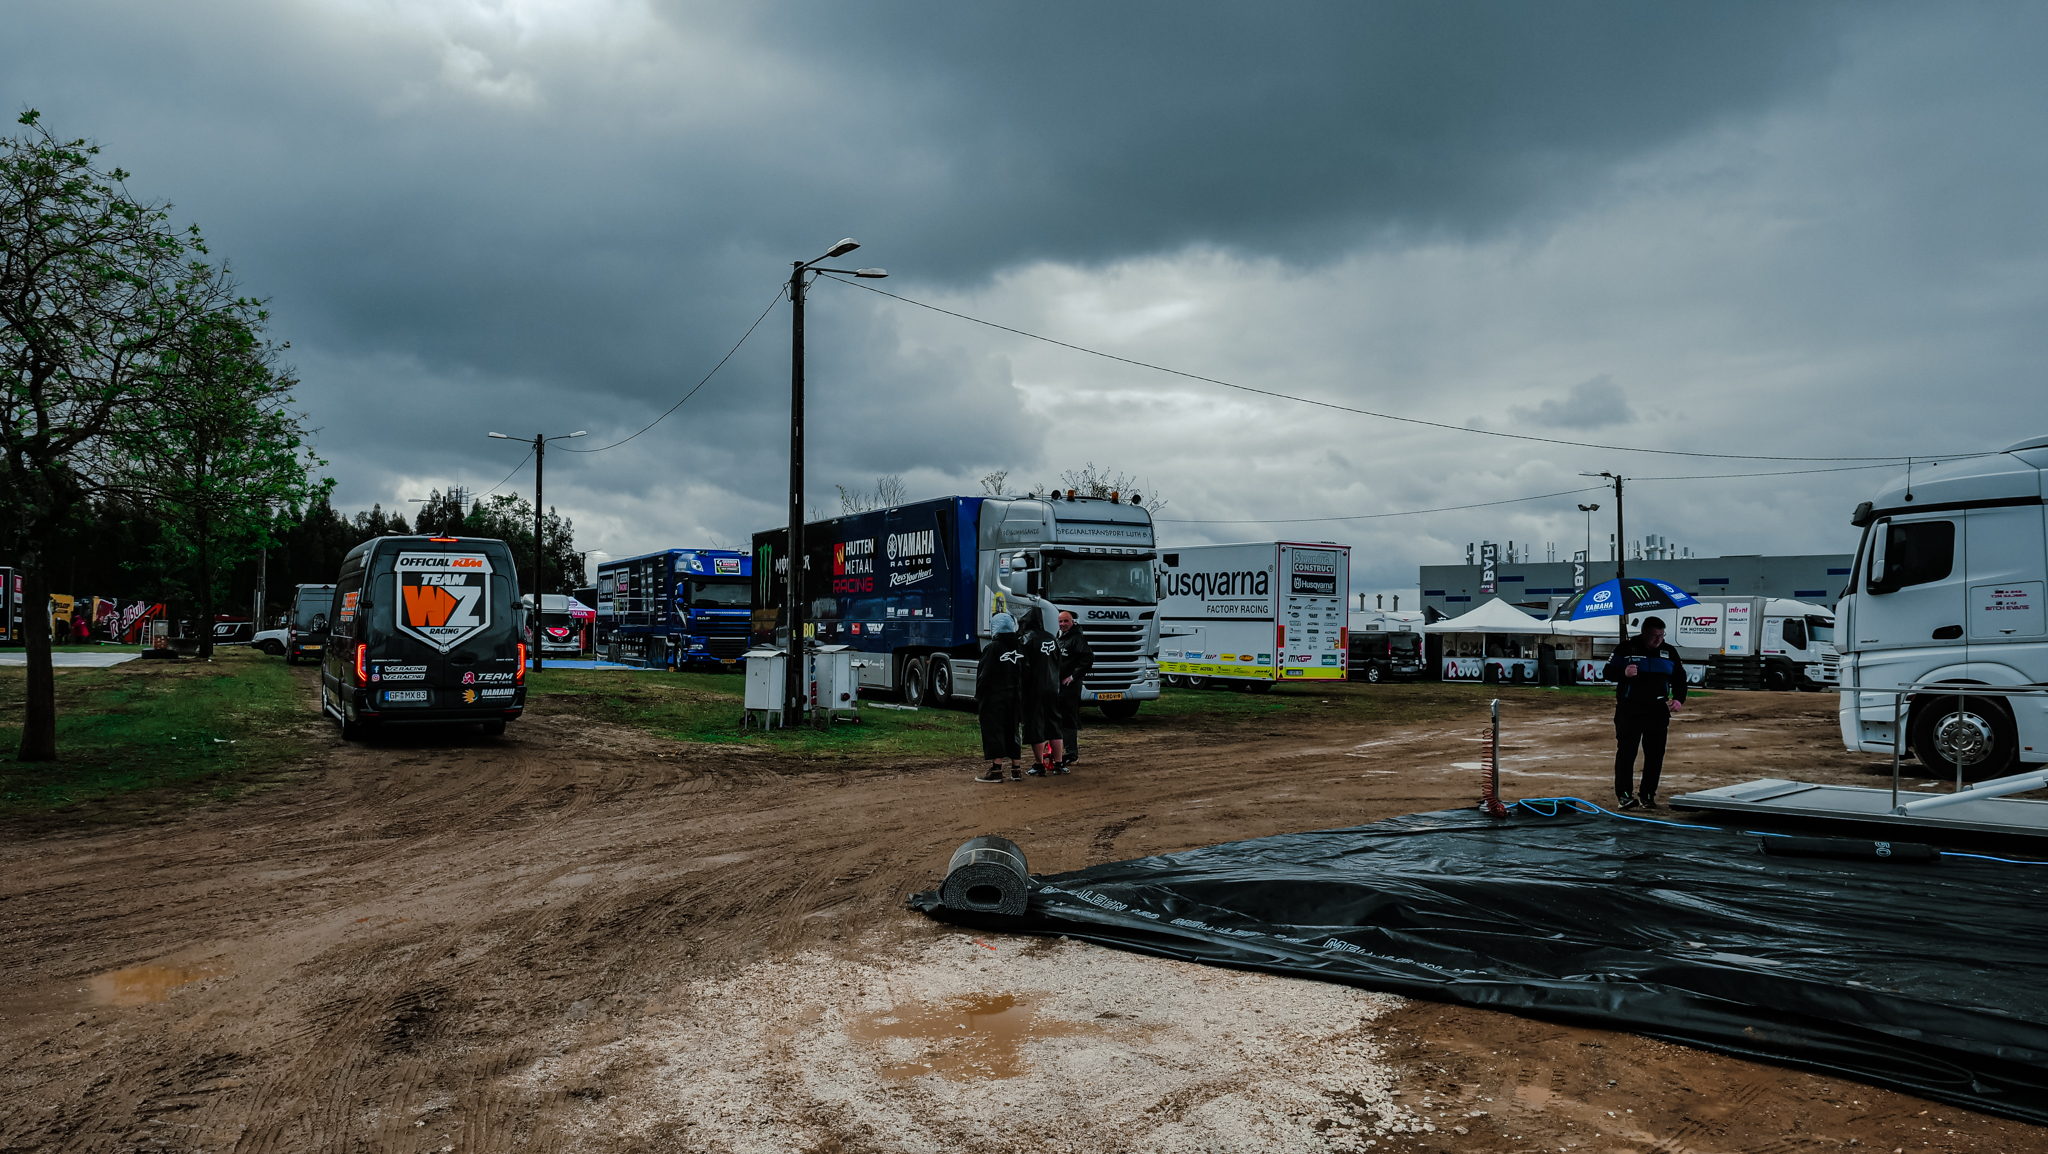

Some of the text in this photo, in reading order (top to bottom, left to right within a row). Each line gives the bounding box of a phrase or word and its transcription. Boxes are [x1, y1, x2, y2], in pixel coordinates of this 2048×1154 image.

[1057, 528, 1124, 537] SPECIAALTRANSPORT
[845, 538, 874, 556] HUTTEN
[897, 530, 935, 557] YAMAHA
[400, 558, 482, 567] OFFICIAL KTM
[845, 558, 874, 575] METAAL
[890, 557, 932, 568] RACING
[1295, 564, 1334, 573] CONSTRUCT
[421, 573, 468, 585] TEAM
[890, 568, 933, 587] Revs Your Heart
[832, 577, 874, 594] RACING
[1167, 570, 1269, 601] usqvarna
[1301, 580, 1334, 590] Husqvarna
[402, 585, 482, 627] WZ
[1206, 604, 1269, 614] FACTORY RACING
[1585, 602, 1614, 612] YAMAHA
[110, 600, 146, 639] Rd Bull
[1087, 610, 1131, 620] SCANIA
[1680, 616, 1718, 626] MXGP
[803, 623, 815, 638] BO
[1288, 655, 1312, 663] MXGP
[1448, 661, 1480, 679] kovo
[1583, 663, 1604, 680] ko
[478, 672, 514, 681] TEAM
